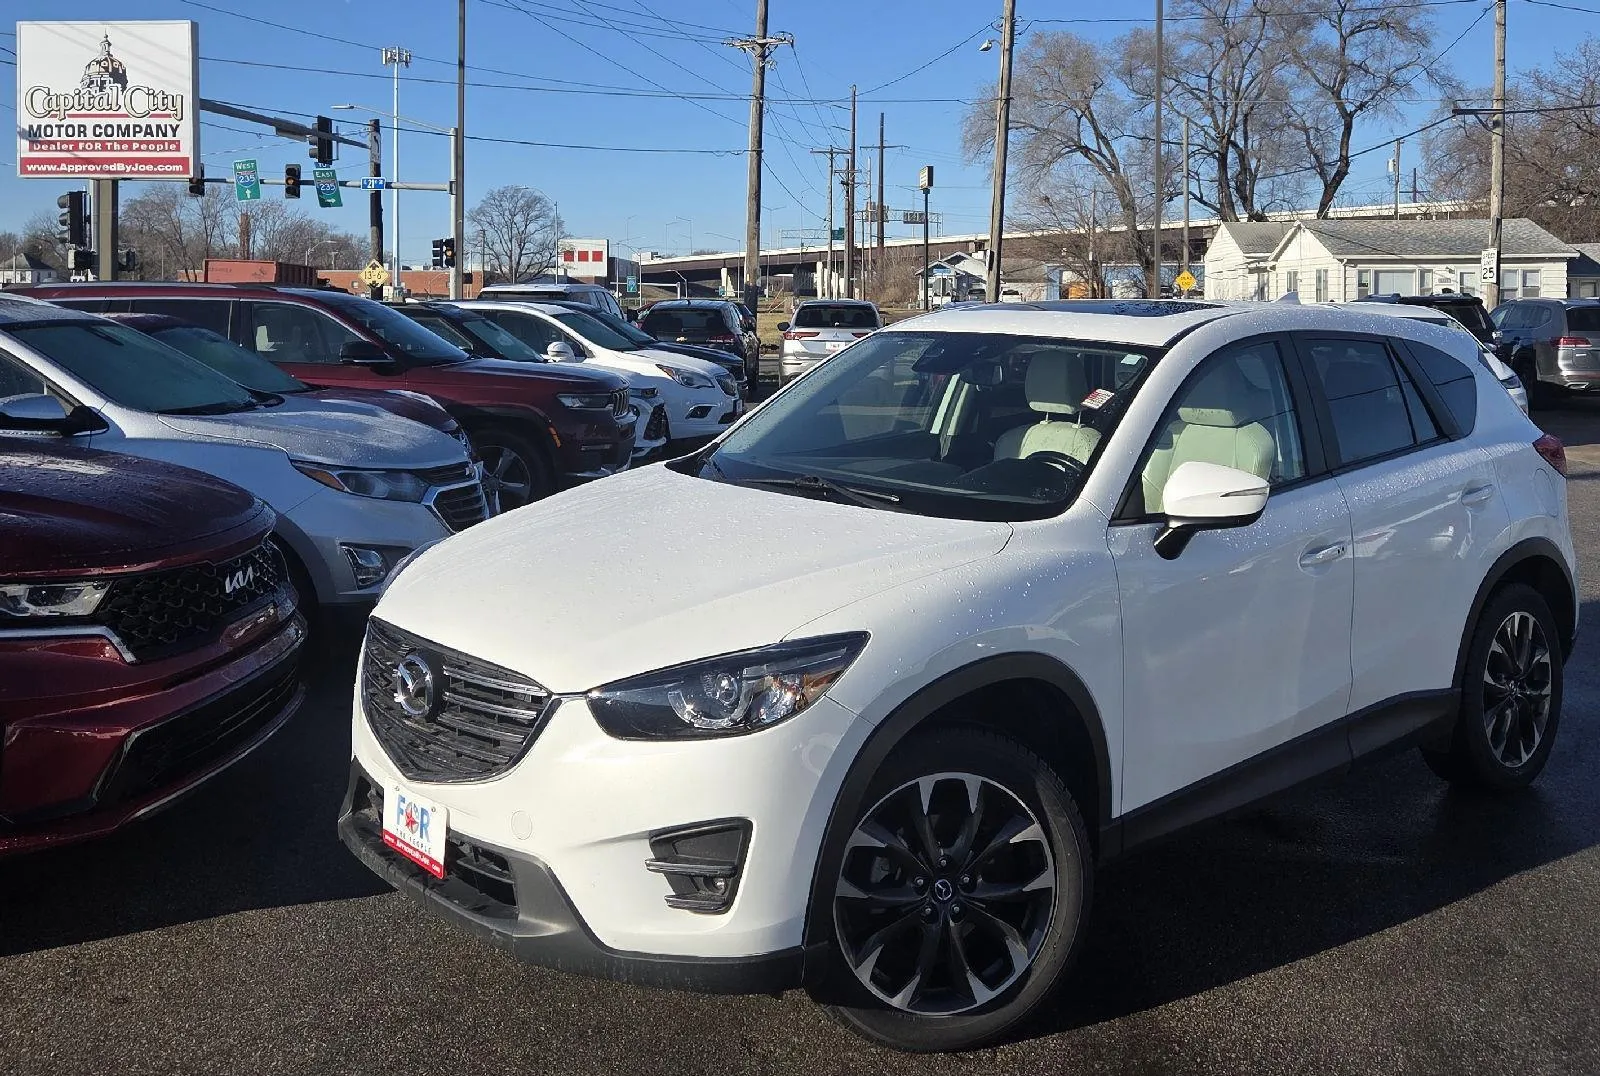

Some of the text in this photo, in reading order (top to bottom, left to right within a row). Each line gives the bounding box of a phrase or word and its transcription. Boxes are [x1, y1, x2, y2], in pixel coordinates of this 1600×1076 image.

[25, 85, 183, 121] Capital City
[28, 123, 181, 138] MOTOR COMPANY
[33, 142, 74, 151] Dealer
[78, 142, 102, 151] FOR
[106, 142, 129, 151] The
[26, 162, 183, 172] www.ApprovedByJoe.com
[235, 162, 255, 170] WEST
[239, 174, 255, 183] 235
[319, 183, 336, 191] 235
[1482, 267, 1495, 279] 25
